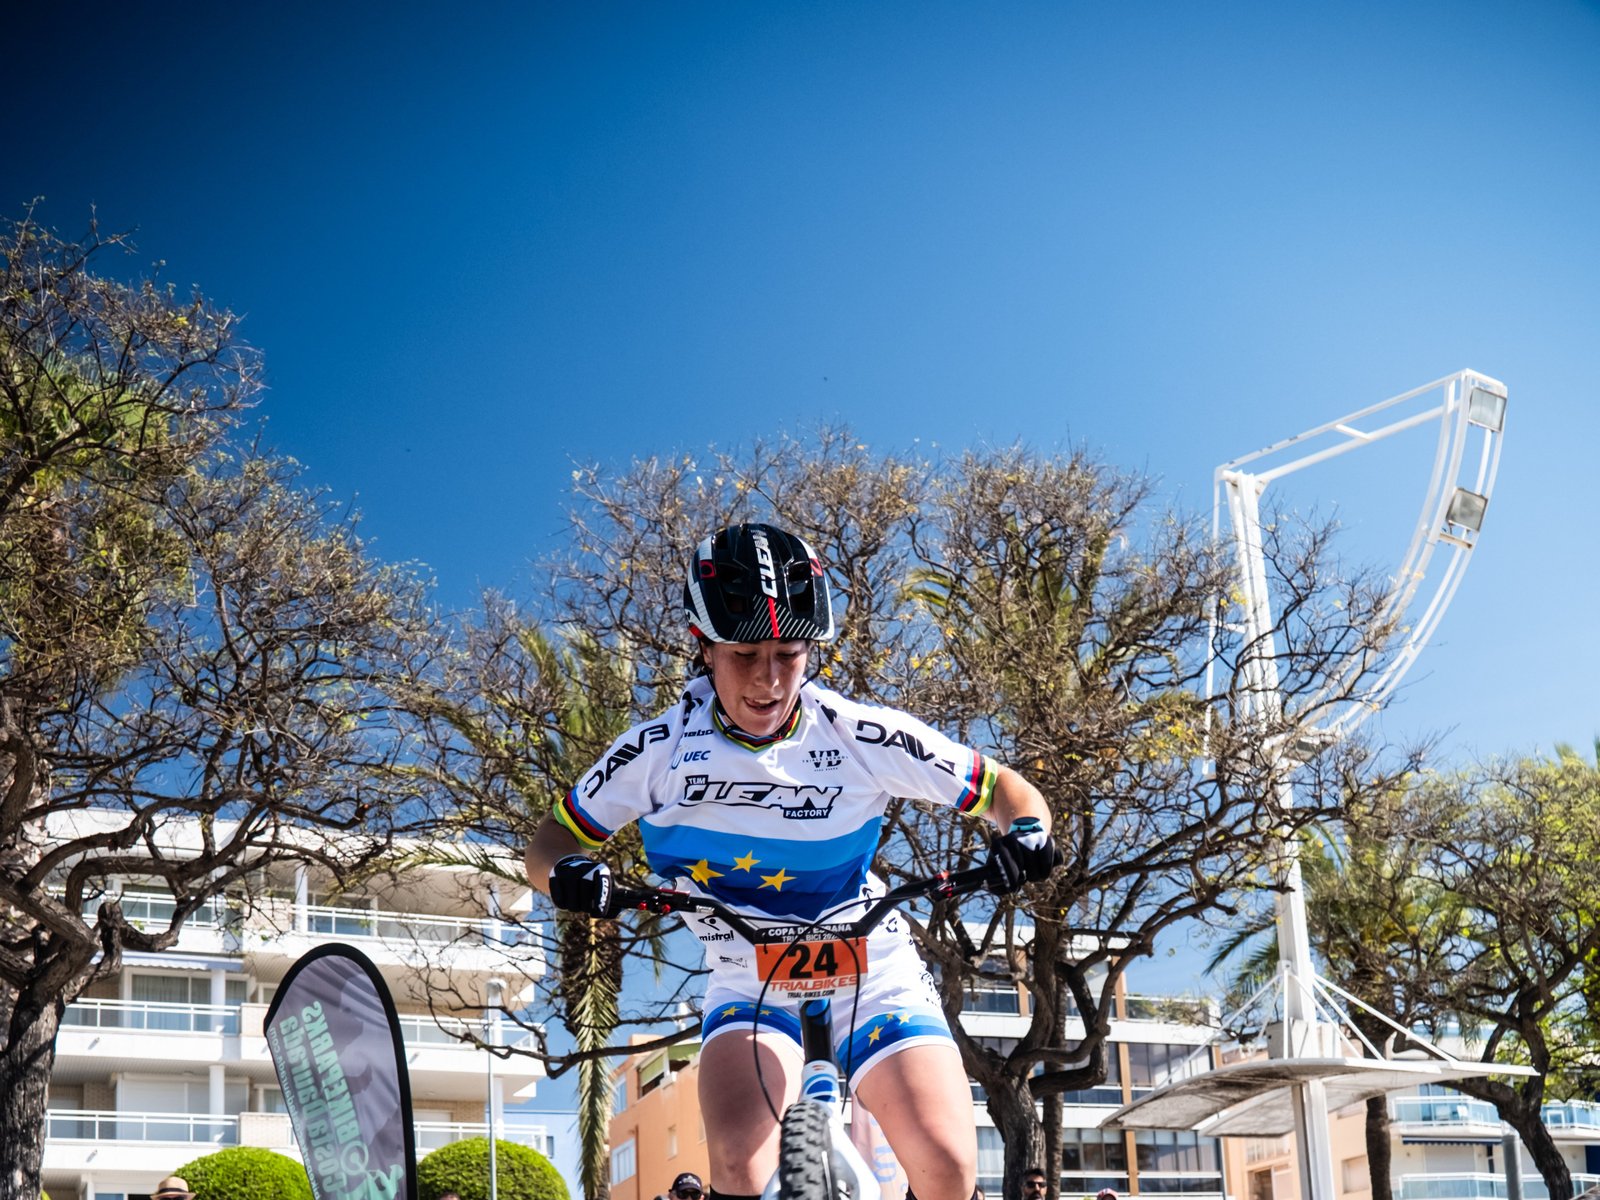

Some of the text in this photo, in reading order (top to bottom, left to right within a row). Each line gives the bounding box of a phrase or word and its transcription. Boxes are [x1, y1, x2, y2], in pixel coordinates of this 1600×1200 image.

[683, 750, 711, 762] UEC
[785, 808, 829, 819] FACTORY
[699, 929, 735, 942] mistral
[768, 928, 796, 937] COPA
[787, 943, 838, 979] 24
[770, 975, 859, 993] TRIALBIKES
[787, 989, 836, 999] TRIAL-BIKES.COM
